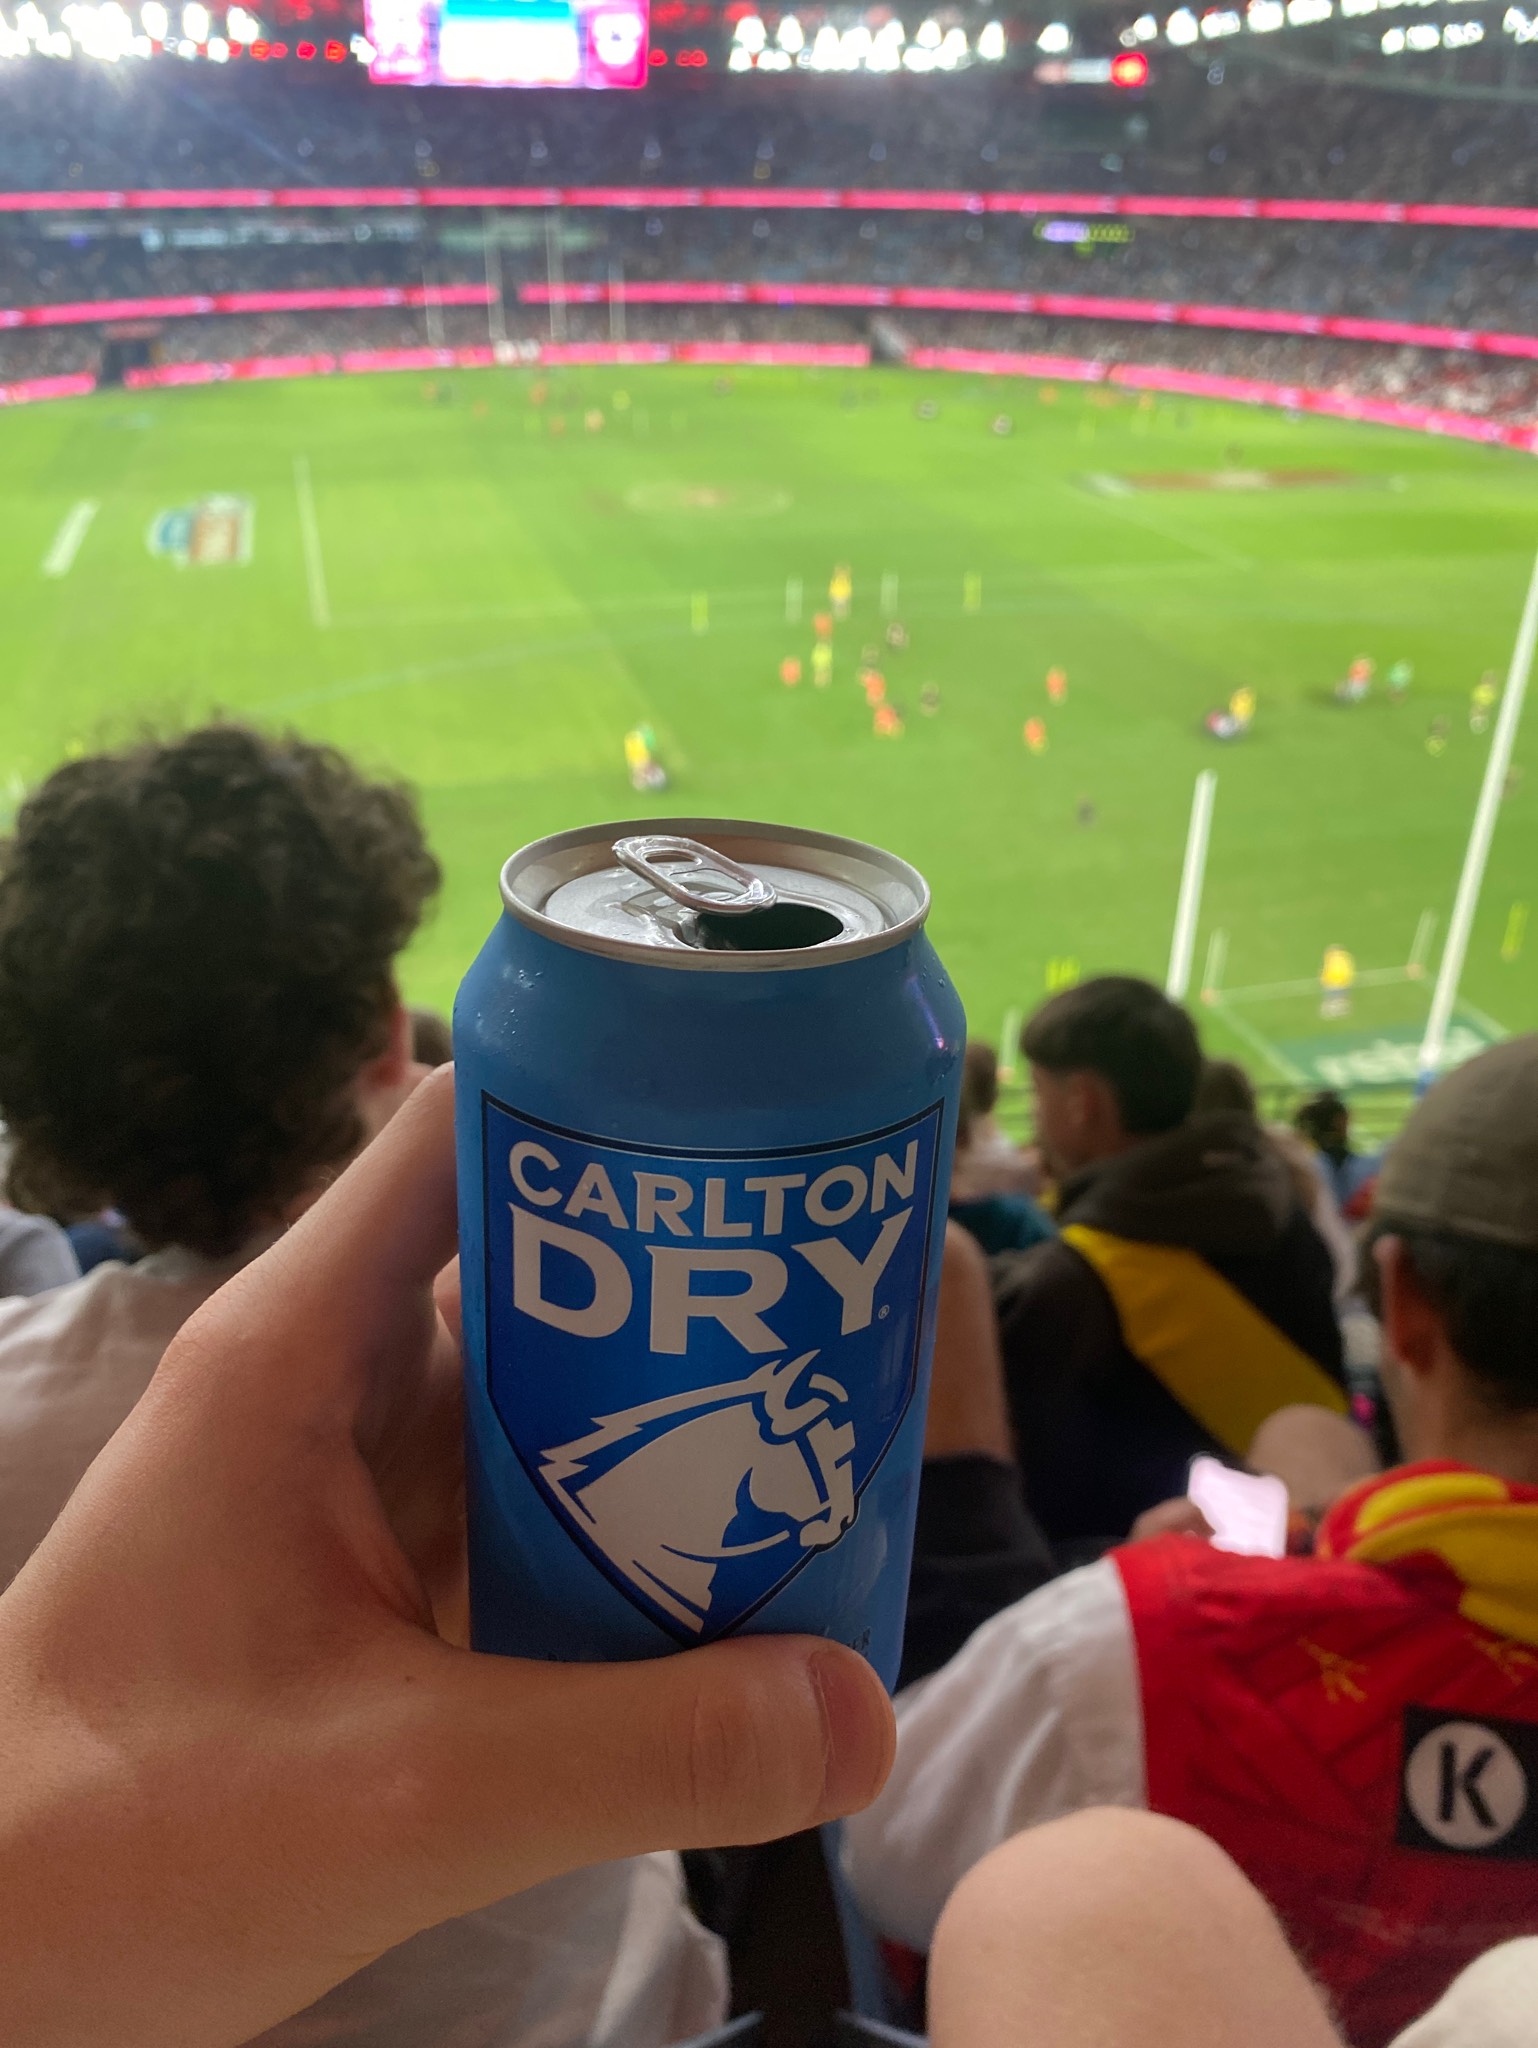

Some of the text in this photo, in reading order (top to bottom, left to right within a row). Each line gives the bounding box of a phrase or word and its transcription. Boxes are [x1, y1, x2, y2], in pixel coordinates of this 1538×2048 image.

[509, 1139, 919, 1238] CARLTON
[509, 1202, 913, 1355] DRY
[1437, 1740, 1499, 1831] K
